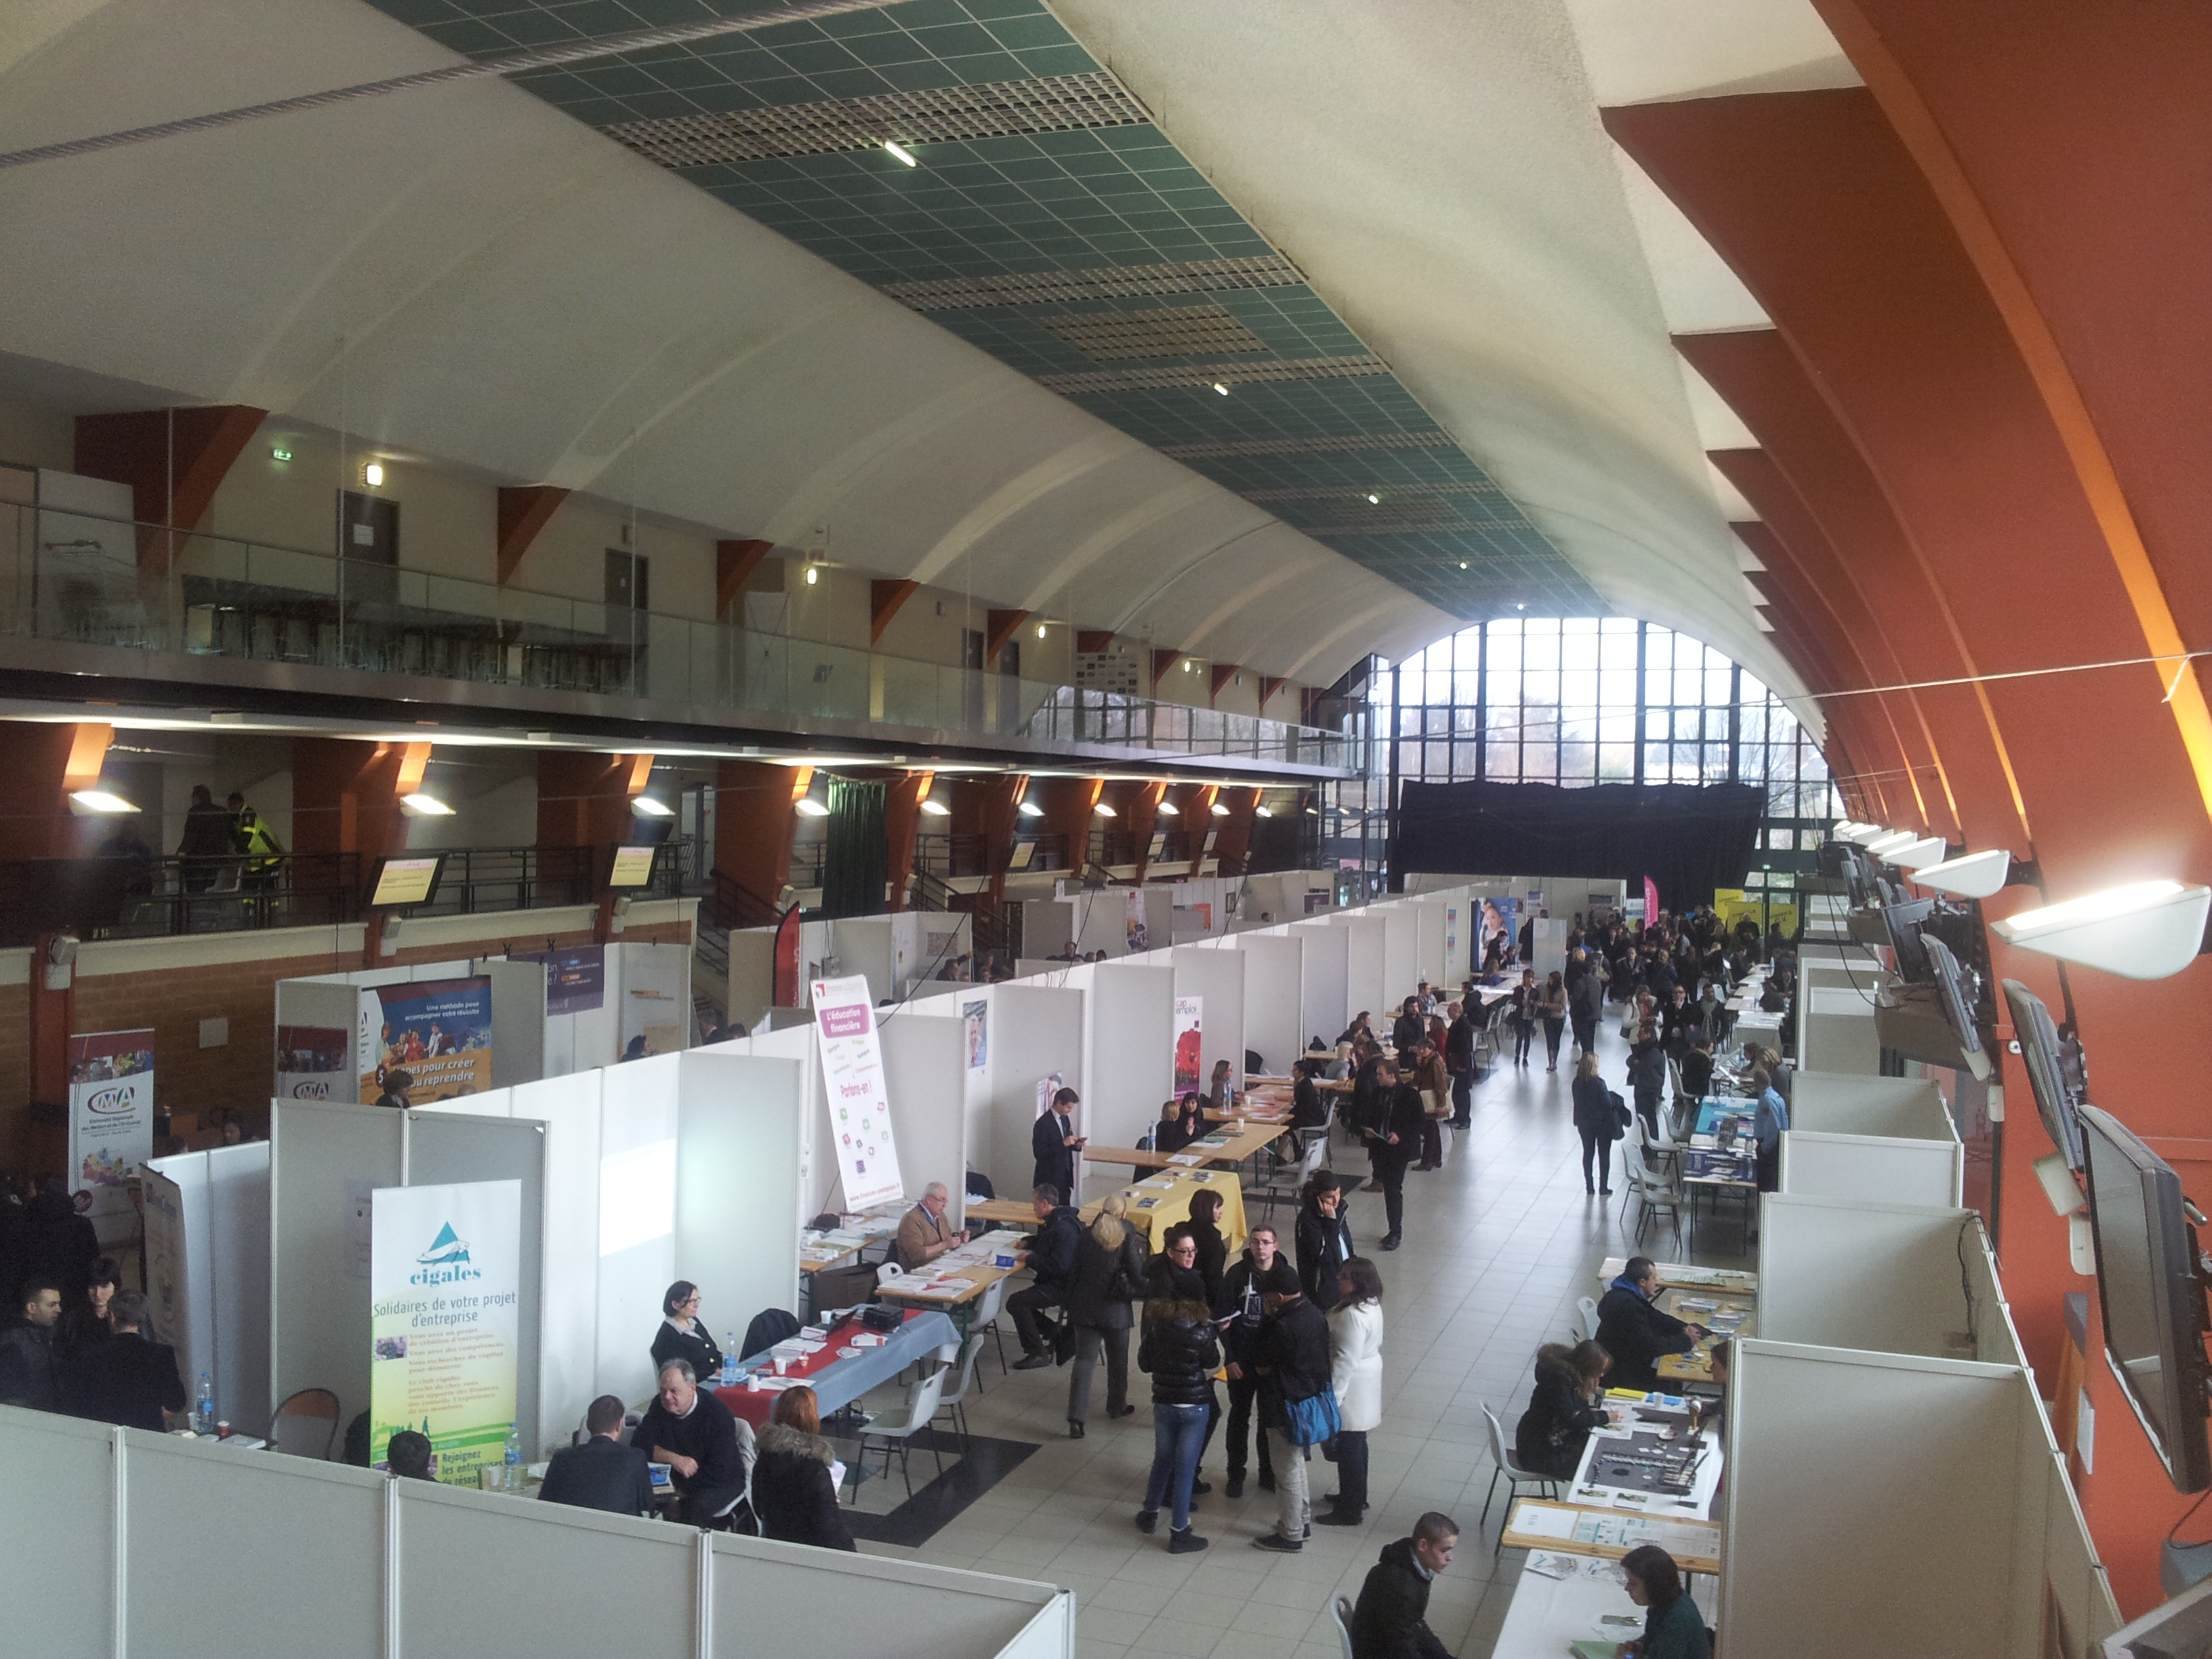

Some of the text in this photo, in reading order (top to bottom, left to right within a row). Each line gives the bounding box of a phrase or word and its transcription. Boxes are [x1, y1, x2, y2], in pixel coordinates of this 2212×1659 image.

[439, 1002, 464, 1010] méthode
[465, 1001, 480, 1009] pour
[405, 1011, 441, 1021] accompagner
[826, 1008, 861, 1021] L'éducation
[830, 1021, 861, 1033] financière
[422, 1061, 447, 1075] pour
[447, 1057, 476, 1069] créer
[424, 1071, 475, 1086] reprendre
[409, 1265, 482, 1288] cigales
[373, 1290, 516, 1317] Solidaires de votre projet
[411, 1310, 478, 1328] d'entreprise
[442, 1450, 481, 1464] Rejoignez
[442, 1465, 453, 1475] les
